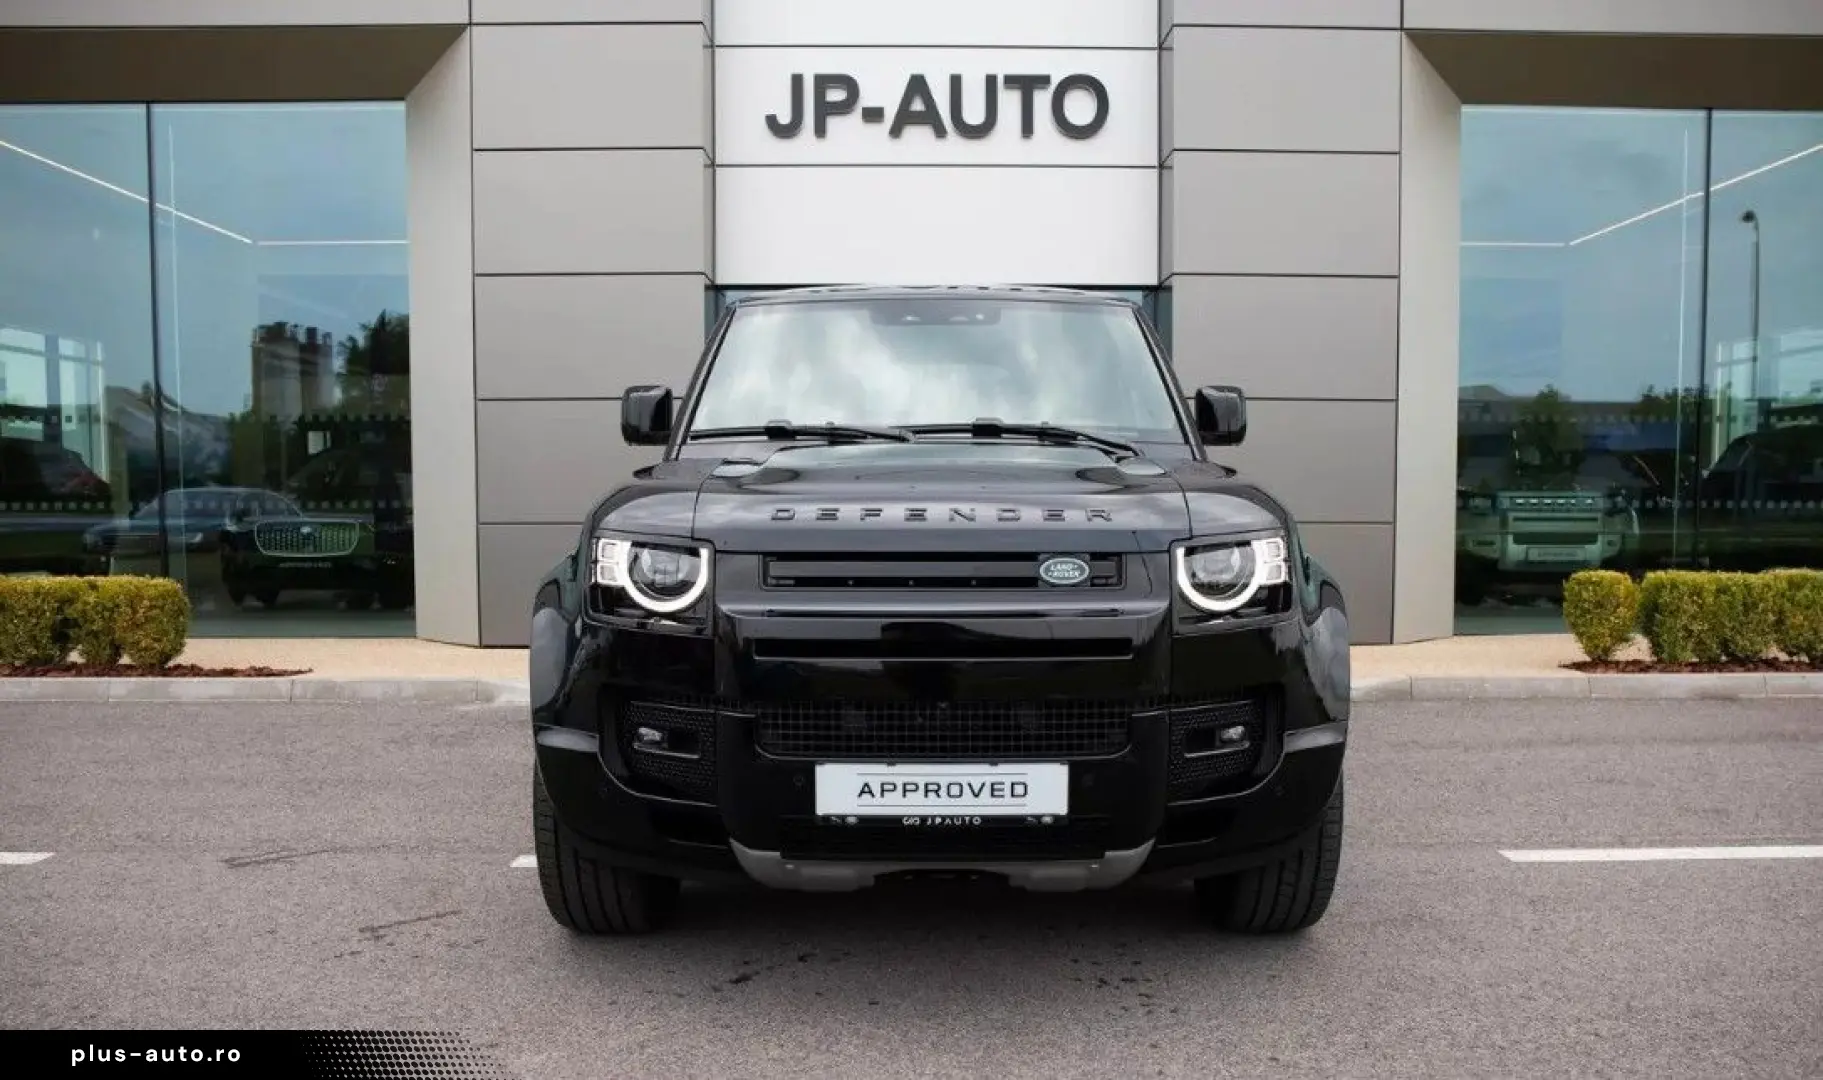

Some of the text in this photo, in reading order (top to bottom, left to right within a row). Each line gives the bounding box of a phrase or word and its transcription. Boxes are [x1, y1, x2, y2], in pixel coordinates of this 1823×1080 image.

[765, 73, 1110, 140] JP-AUTO
[770, 507, 1113, 522] DEFENDER
[857, 781, 1029, 799] APPROVED
